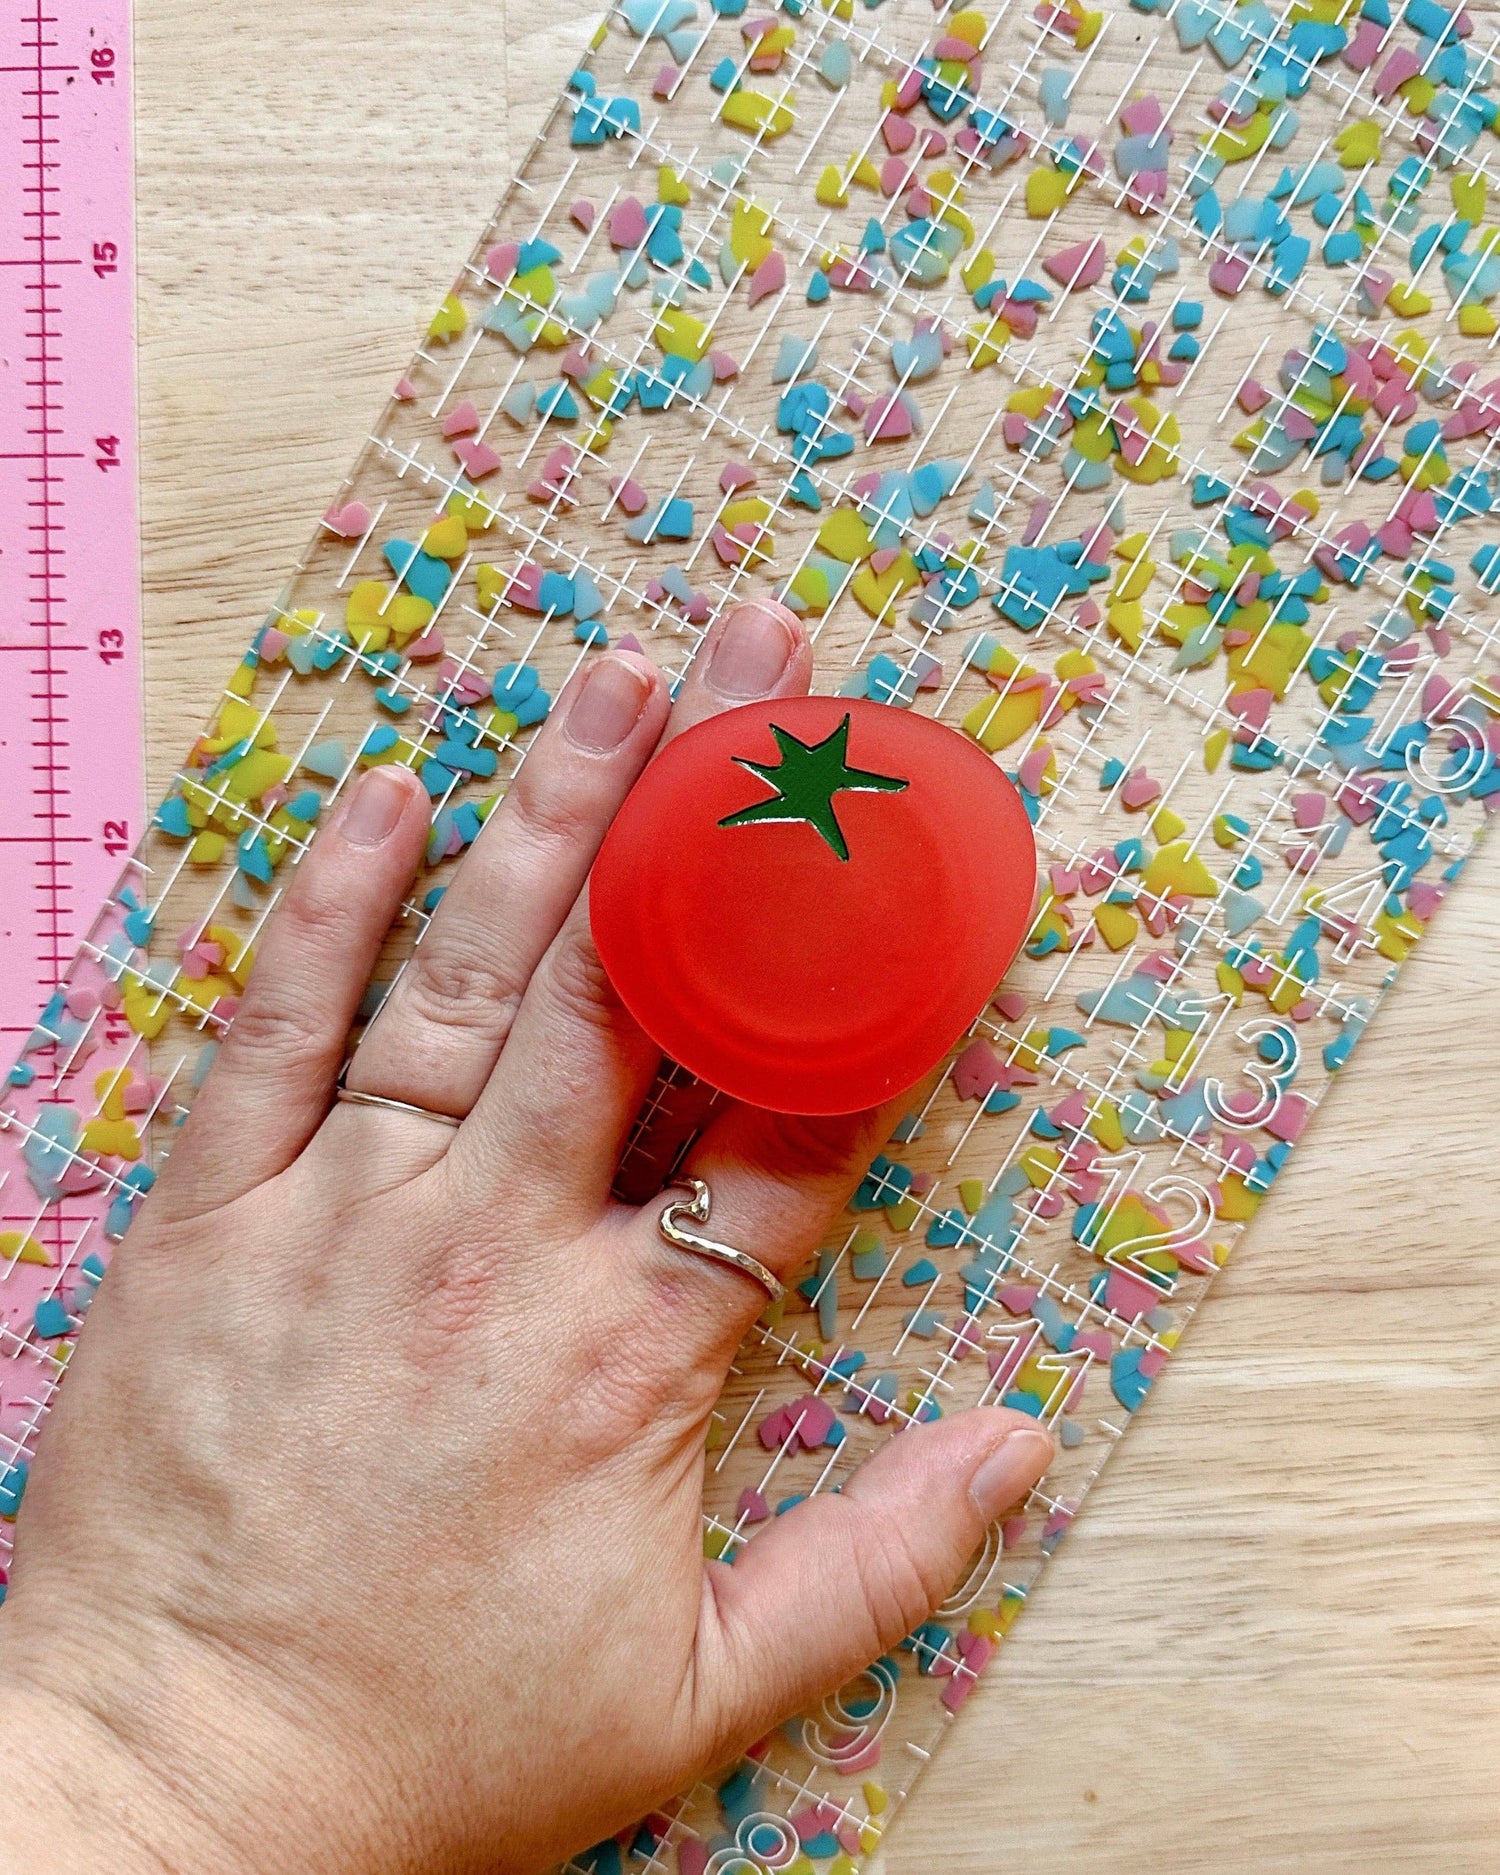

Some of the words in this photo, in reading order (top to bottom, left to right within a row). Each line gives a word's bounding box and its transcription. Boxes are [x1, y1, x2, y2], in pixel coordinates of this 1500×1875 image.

[92, 47, 116, 85] 16
[94, 241, 118, 279] 15
[96, 435, 121, 473] 14
[99, 628, 125, 665] 13
[1364, 653, 1500, 793] 15
[104, 820, 129, 857] 12
[1266, 823, 1406, 964] 14
[105, 1012, 130, 1045] 11
[1164, 994, 1300, 1130] 13
[1077, 1150, 1215, 1297] 12
[977, 1318, 1096, 1431] 11
